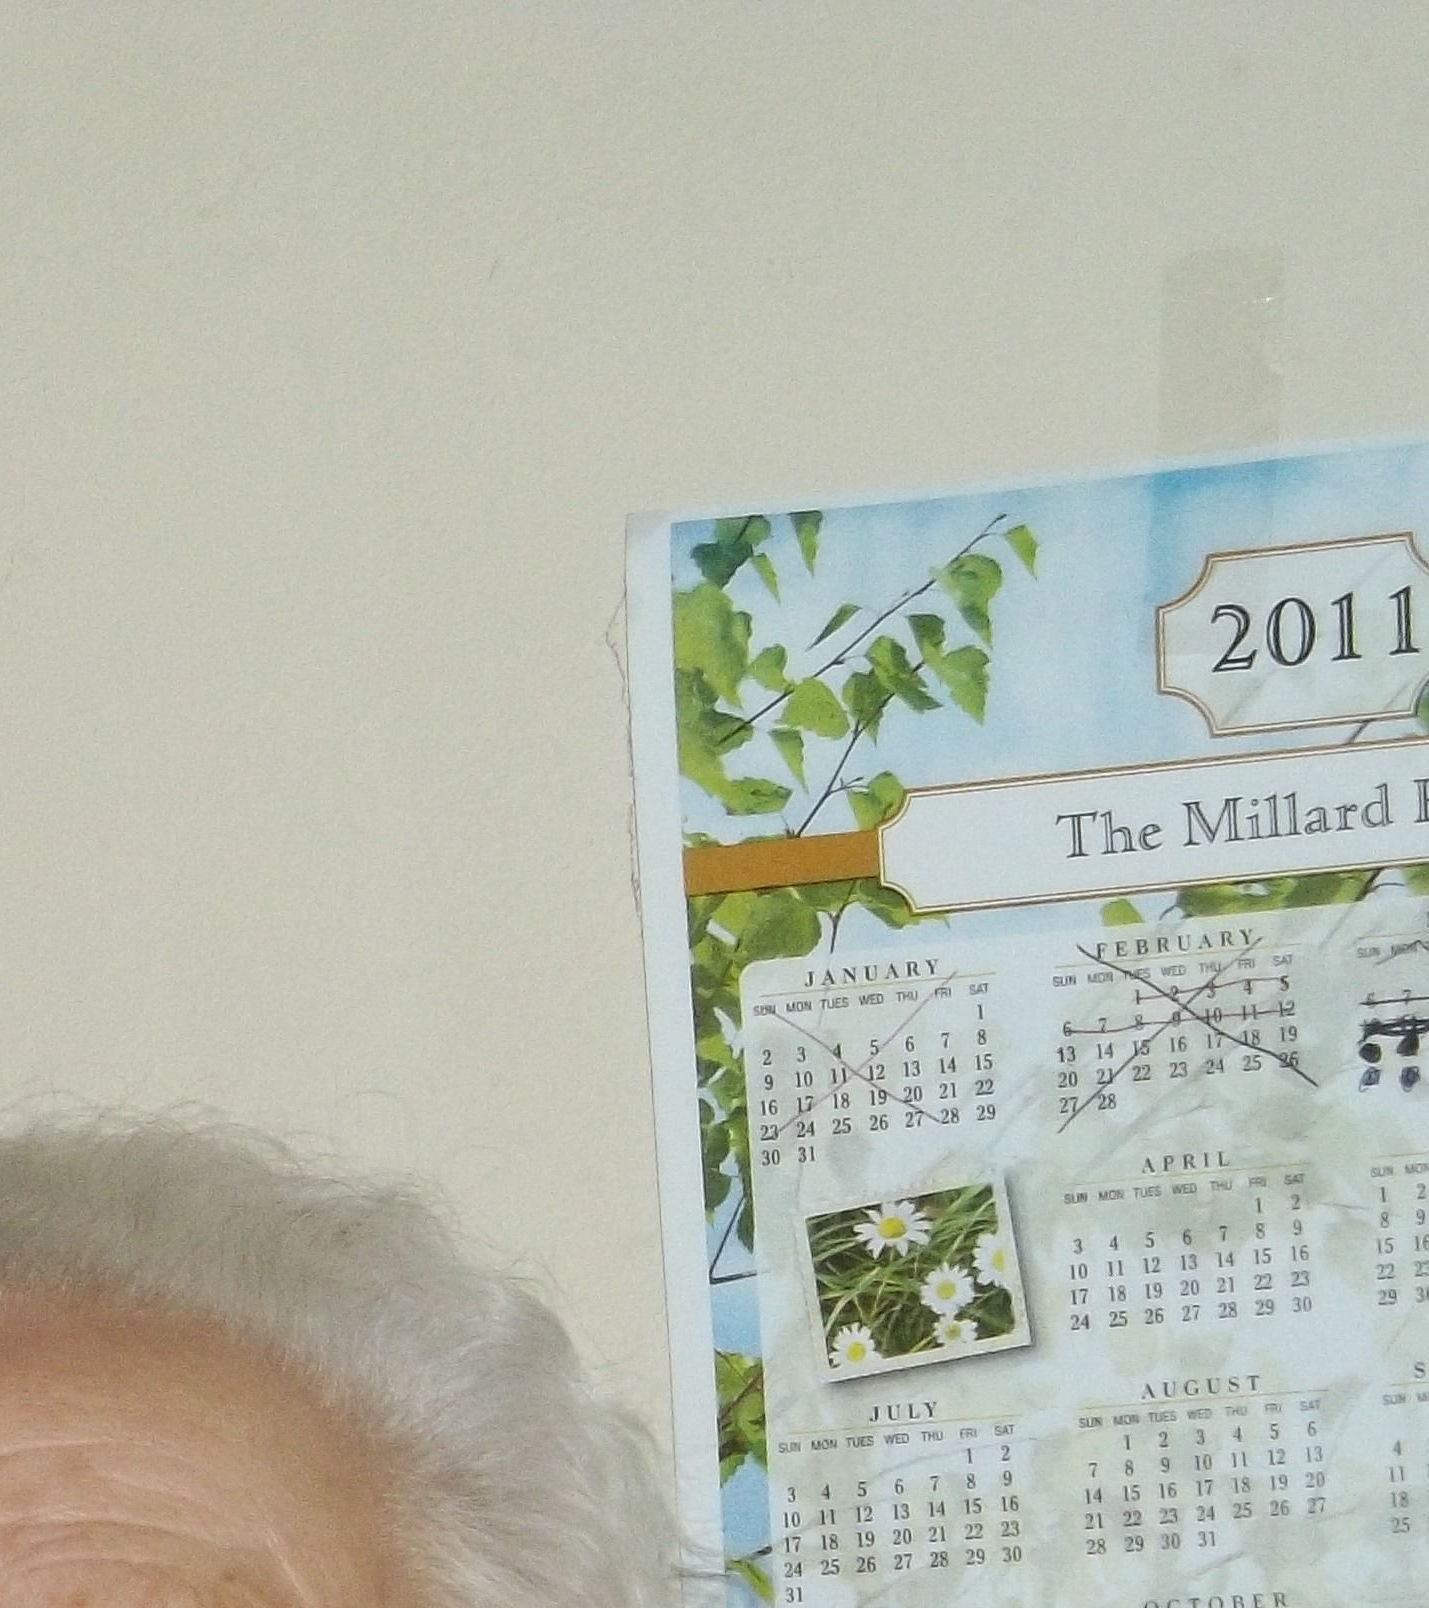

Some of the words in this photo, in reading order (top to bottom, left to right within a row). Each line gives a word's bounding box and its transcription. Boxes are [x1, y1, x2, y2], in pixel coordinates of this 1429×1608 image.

[1211, 585, 1420, 673] 2011
[1056, 810, 1162, 859] The
[1182, 783, 1394, 847] Millard
[1096, 929, 1254, 958] FEBRUARY
[805, 959, 939, 988] JANUARY
[753, 1004, 776, 1016] SUN
[786, 1001, 812, 1013] MON
[821, 997, 849, 1010] TUES
[859, 994, 884, 1006] WED
[896, 991, 918, 1002] THU
[934, 987, 951, 998] FRI
[969, 983, 989, 996] SAT
[977, 1003, 984, 1020] 1
[762, 1049, 773, 1066] 2
[796, 1046, 807, 1063] 3
[869, 1039, 880, 1057] 5
[905, 1035, 915, 1053] 6
[940, 1031, 950, 1049] 7
[976, 1028, 987, 1046] 8
[764, 1074, 774, 1091] 9
[795, 1070, 814, 1088] 10
[903, 1060, 921, 1078] 13
[939, 1056, 957, 1074] 14
[975, 1053, 993, 1071] 15
[761, 1148, 781, 1166] 30
[797, 1145, 815, 1164] 31
[1141, 1151, 1229, 1174] APRIL
[1255, 1197, 1262, 1214] 1
[1290, 1193, 1302, 1211] 2
[1072, 1238, 1084, 1255] 3
[1109, 1235, 1118, 1251] 4
[1144, 1231, 1155, 1249] 5
[1182, 1228, 1193, 1246] 6
[1218, 1224, 1229, 1242] 7
[1255, 1222, 1266, 1240] 8
[1292, 1218, 1303, 1237] 9
[1070, 1263, 1088, 1281] 10
[1107, 1259, 1124, 1277] 11
[1142, 1256, 1162, 1275] 12
[1180, 1253, 1198, 1272] 13
[1215, 1251, 1235, 1268] 14
[1253, 1247, 1272, 1265] 15
[1290, 1244, 1310, 1262] 16
[1070, 1288, 1089, 1306] 17
[1108, 1284, 1127, 1303] 18
[1145, 1282, 1164, 1300] 19
[1180, 1279, 1200, 1297] 20
[1216, 1276, 1235, 1294] 21
[1253, 1272, 1273, 1291] 22
[1290, 1269, 1310, 1288] 23
[1070, 1313, 1090, 1331] 24
[1108, 1310, 1129, 1328] 25
[1144, 1307, 1164, 1325] 26
[1181, 1304, 1201, 1322] 27
[1218, 1301, 1238, 1319] 28
[1254, 1298, 1275, 1317] 29
[1292, 1295, 1313, 1313] 30
[1141, 1375, 1260, 1399] AUGUST
[869, 1401, 937, 1422] JULY
[778, 1442, 801, 1453] SUN
[811, 1439, 837, 1451] MON
[845, 1436, 874, 1448] TUES
[884, 1433, 909, 1445] WED
[921, 1430, 944, 1442] THU
[959, 1427, 978, 1439] FRI
[994, 1424, 1014, 1437] SAT
[965, 1447, 973, 1465] 1
[1000, 1444, 1011, 1462] 2
[787, 1486, 797, 1503] 3
[821, 1484, 831, 1500] 4
[857, 1480, 868, 1498] 5
[894, 1478, 905, 1495] 6
[929, 1475, 940, 1492] 7
[966, 1472, 977, 1490] 8
[1002, 1470, 1013, 1487] 9
[784, 1511, 801, 1529] 10
[820, 1508, 836, 1526] 11
[855, 1505, 873, 1523] 12
[893, 1502, 910, 1521] 13
[928, 1500, 946, 1518] 14
[963, 1497, 982, 1515] 15
[1001, 1495, 1020, 1513] 16
[784, 1535, 801, 1554] 17
[821, 1533, 839, 1551] 18
[855, 1530, 875, 1549] 19
[892, 1527, 912, 1546] 20
[928, 1525, 947, 1543] 21
[964, 1522, 984, 1541] 22
[1000, 1520, 1021, 1538] 23
[783, 1561, 803, 1579] 24
[820, 1558, 841, 1576] 25
[855, 1555, 877, 1574] 26
[893, 1553, 913, 1571] 27
[929, 1550, 950, 1569] 28
[965, 1548, 986, 1566] 29
[1001, 1545, 1022, 1564] 30
[785, 1586, 803, 1604] 31
